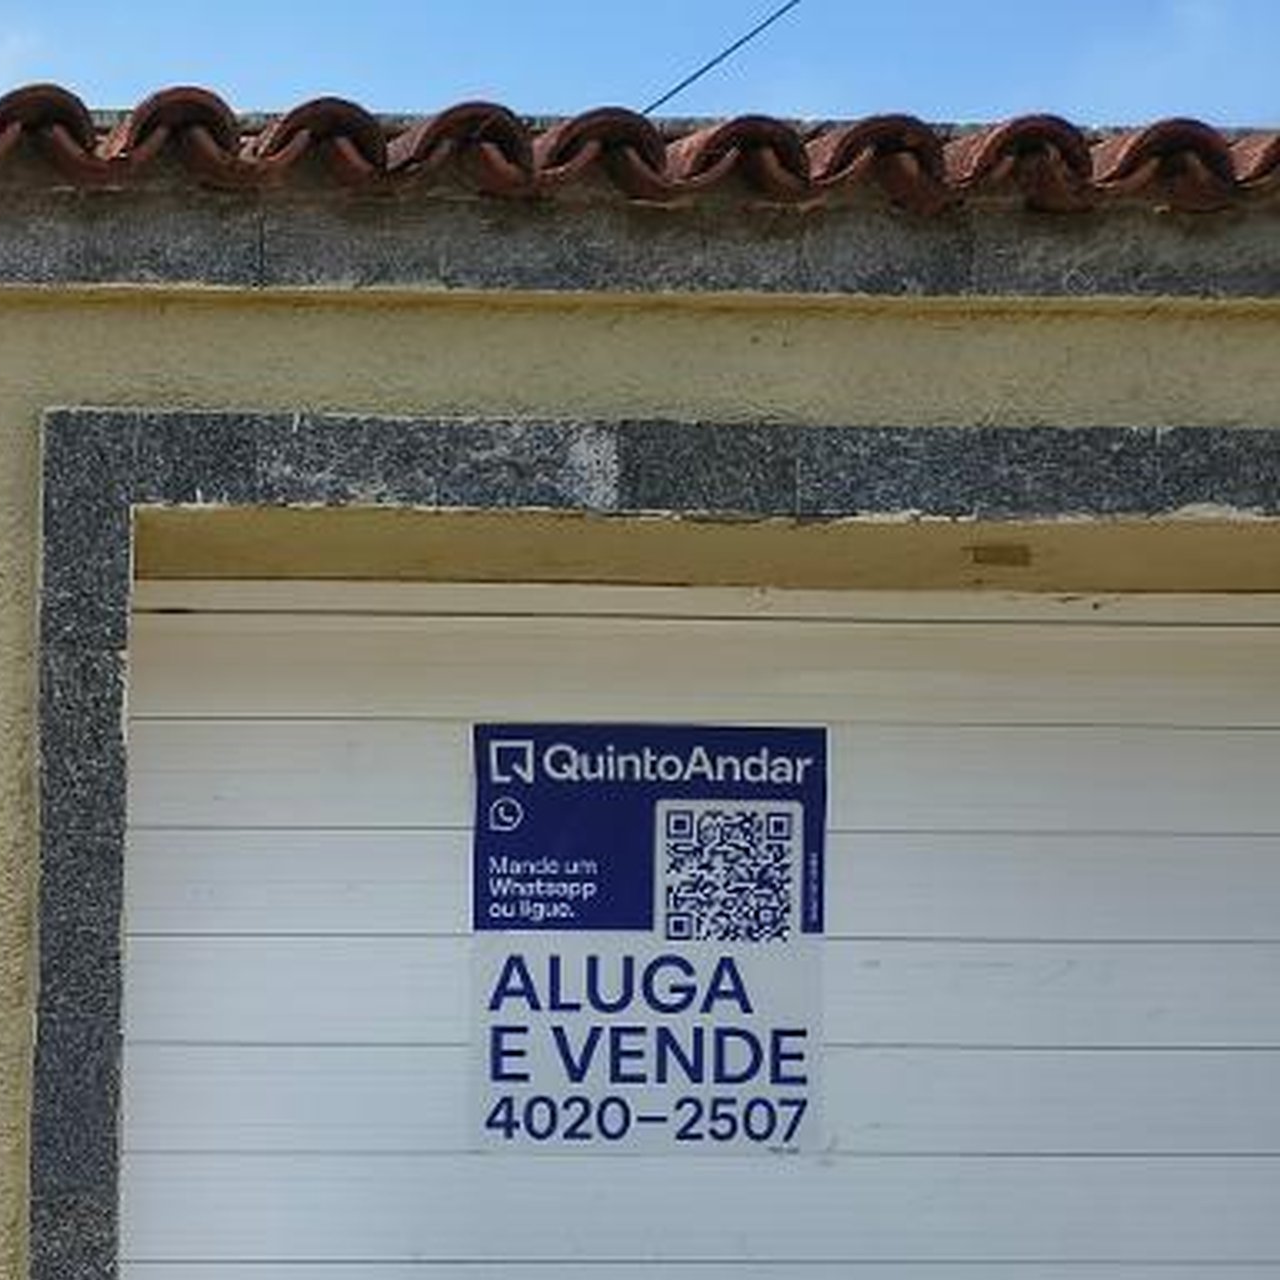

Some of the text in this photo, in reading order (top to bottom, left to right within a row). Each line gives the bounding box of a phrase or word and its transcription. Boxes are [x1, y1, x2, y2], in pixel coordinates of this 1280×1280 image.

[543, 743, 813, 784] QuintoAndar
[488, 856, 598, 875] Mande um
[488, 902, 516, 918] ou
[487, 954, 754, 1014] ALUGA
[489, 1026, 808, 1086] E VENDE
[485, 1095, 808, 1143] 4020-2507
